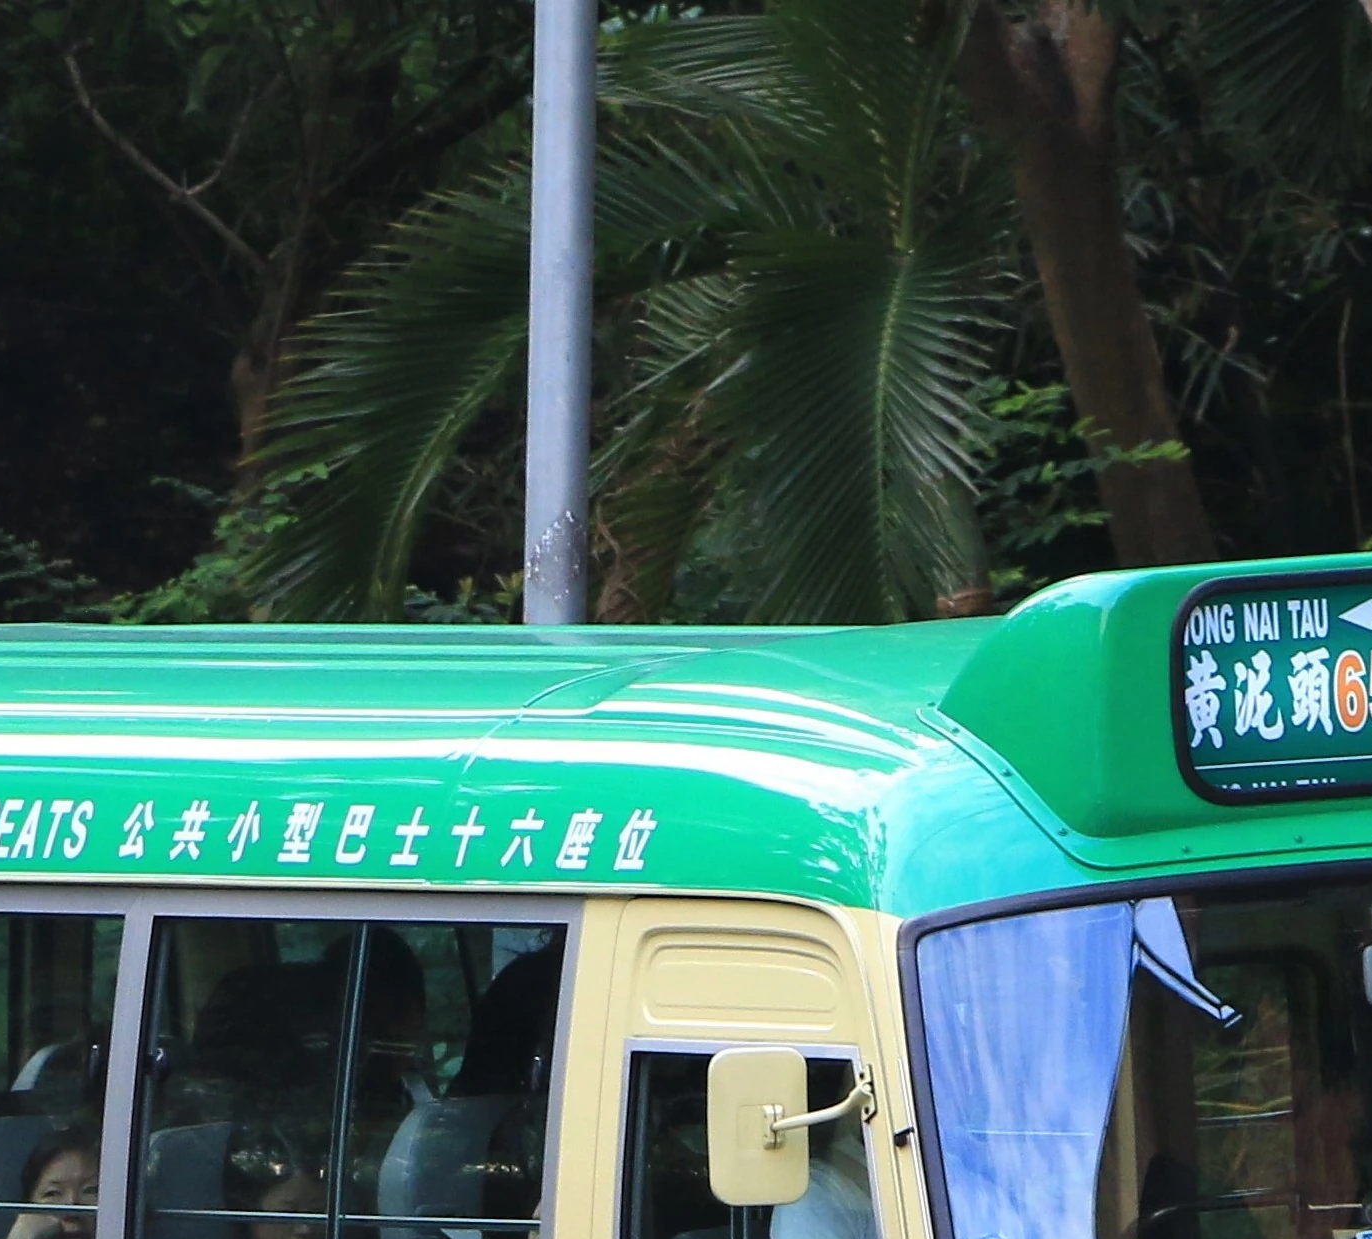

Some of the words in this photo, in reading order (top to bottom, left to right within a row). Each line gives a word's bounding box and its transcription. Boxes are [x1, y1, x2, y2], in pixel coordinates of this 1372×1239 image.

[1243, 601, 1280, 642] NAI
[1287, 597, 1329, 638] TAU
[117, 799, 659, 872] 公共小型巴士十六座位
